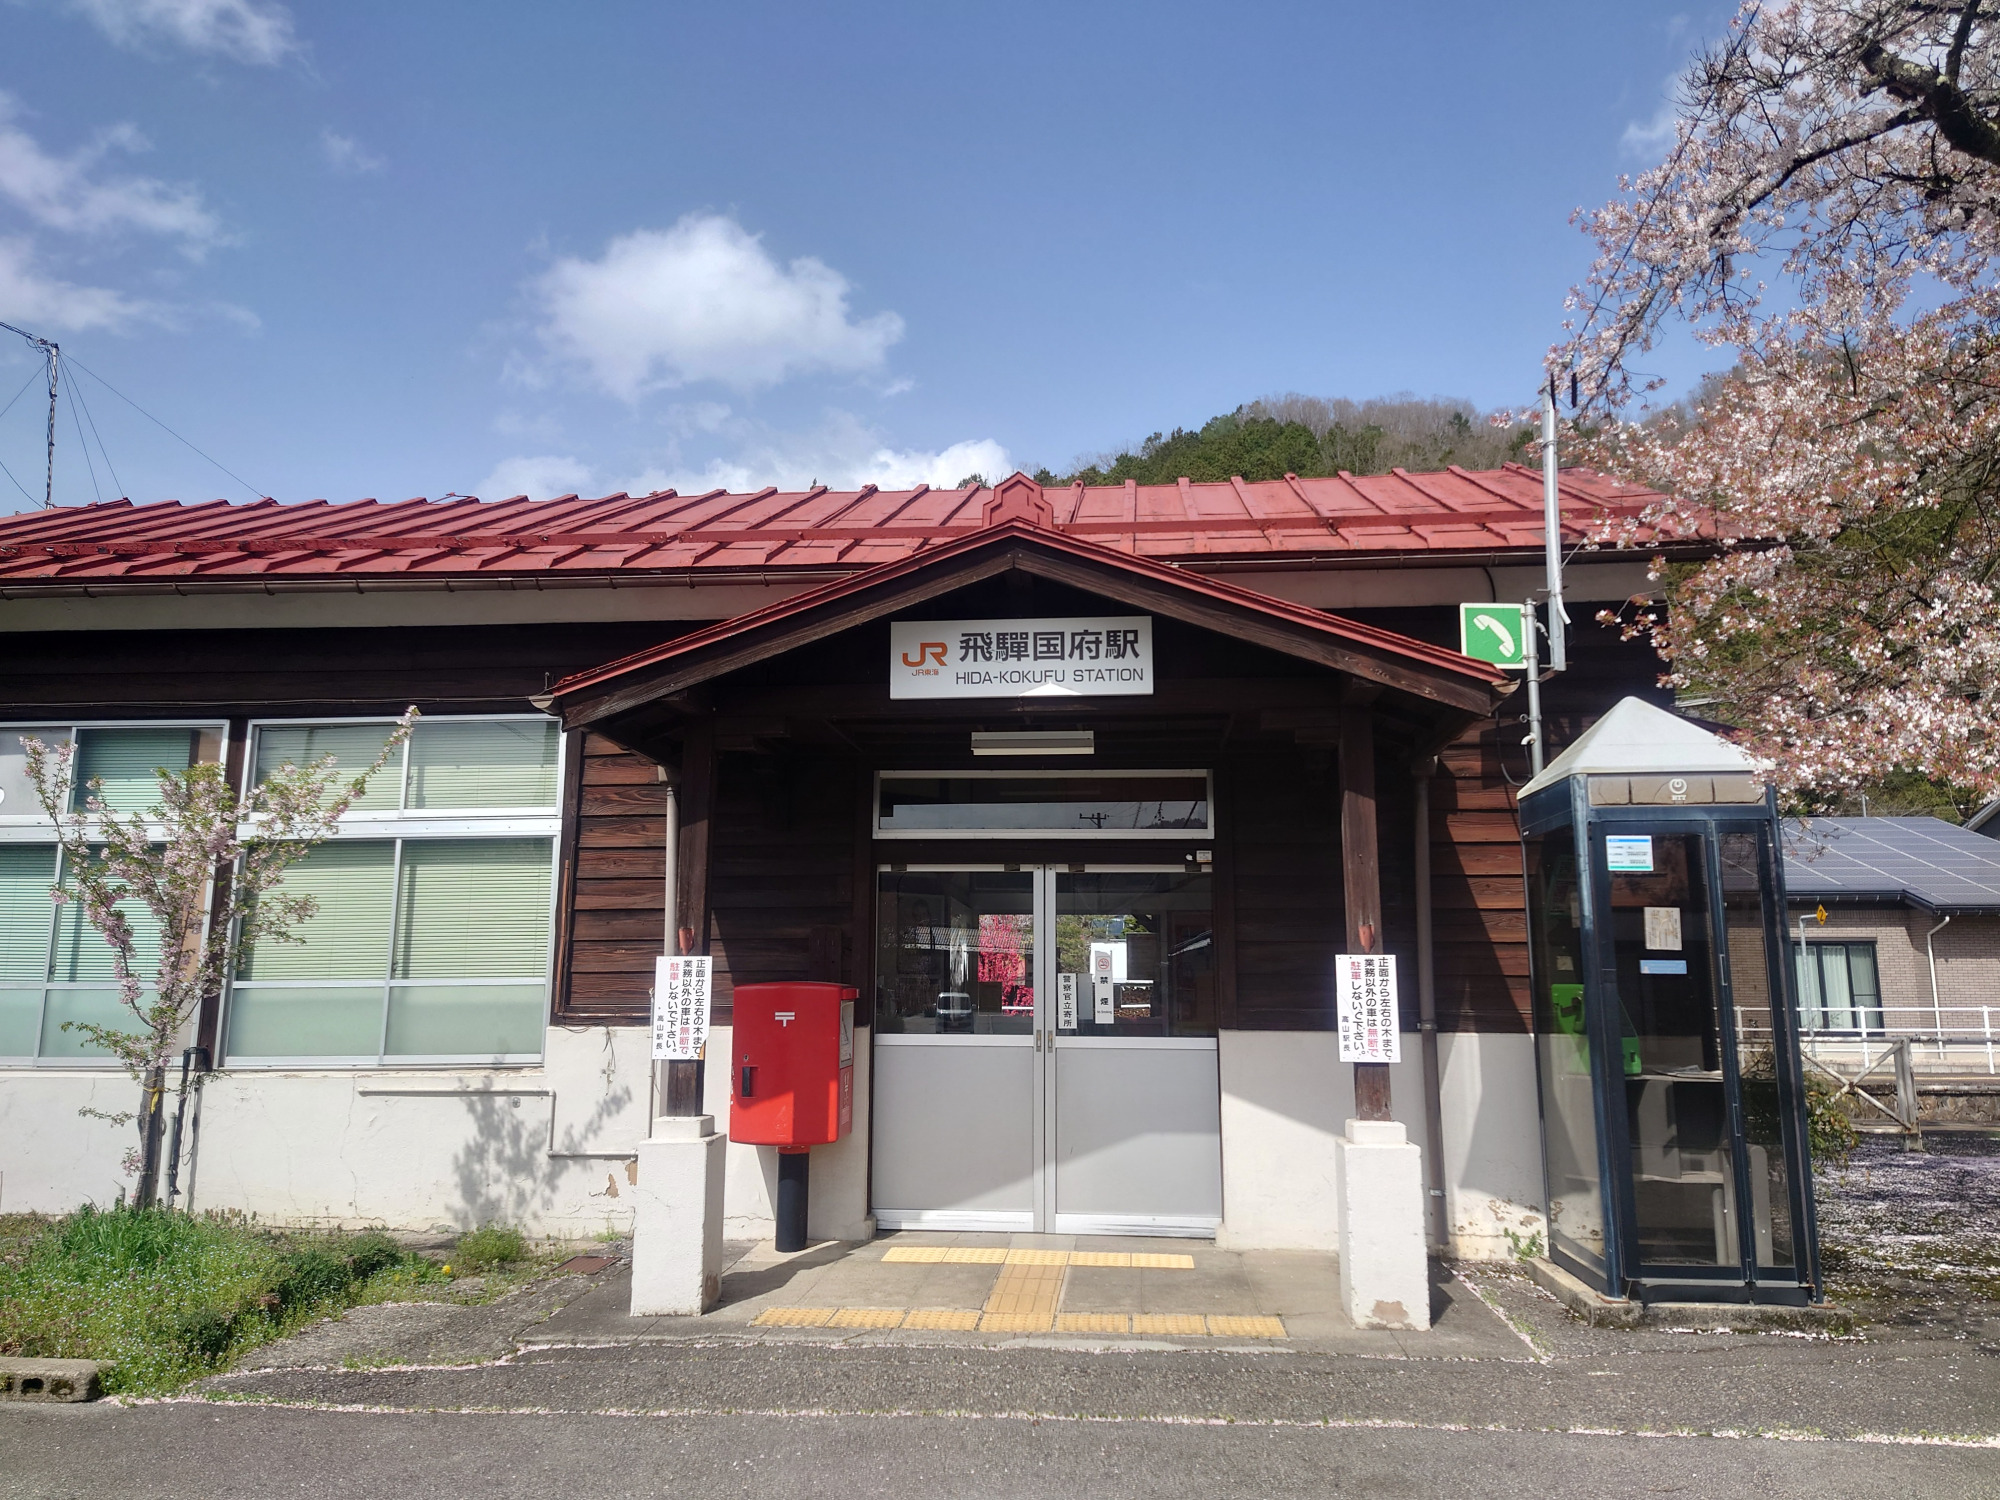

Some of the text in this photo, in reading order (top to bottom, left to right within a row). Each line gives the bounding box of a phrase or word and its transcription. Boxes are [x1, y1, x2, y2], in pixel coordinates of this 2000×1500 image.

[902, 642, 948, 667] JR
[955, 668, 1144, 685] HIDA-KOKUFU STATION
[679, 960, 693, 1055] 業務以外の車は無断で
[1063, 975, 1073, 1027] 警察官立寄所
[1364, 959, 1379, 1058] 業務以外の車は無断で
